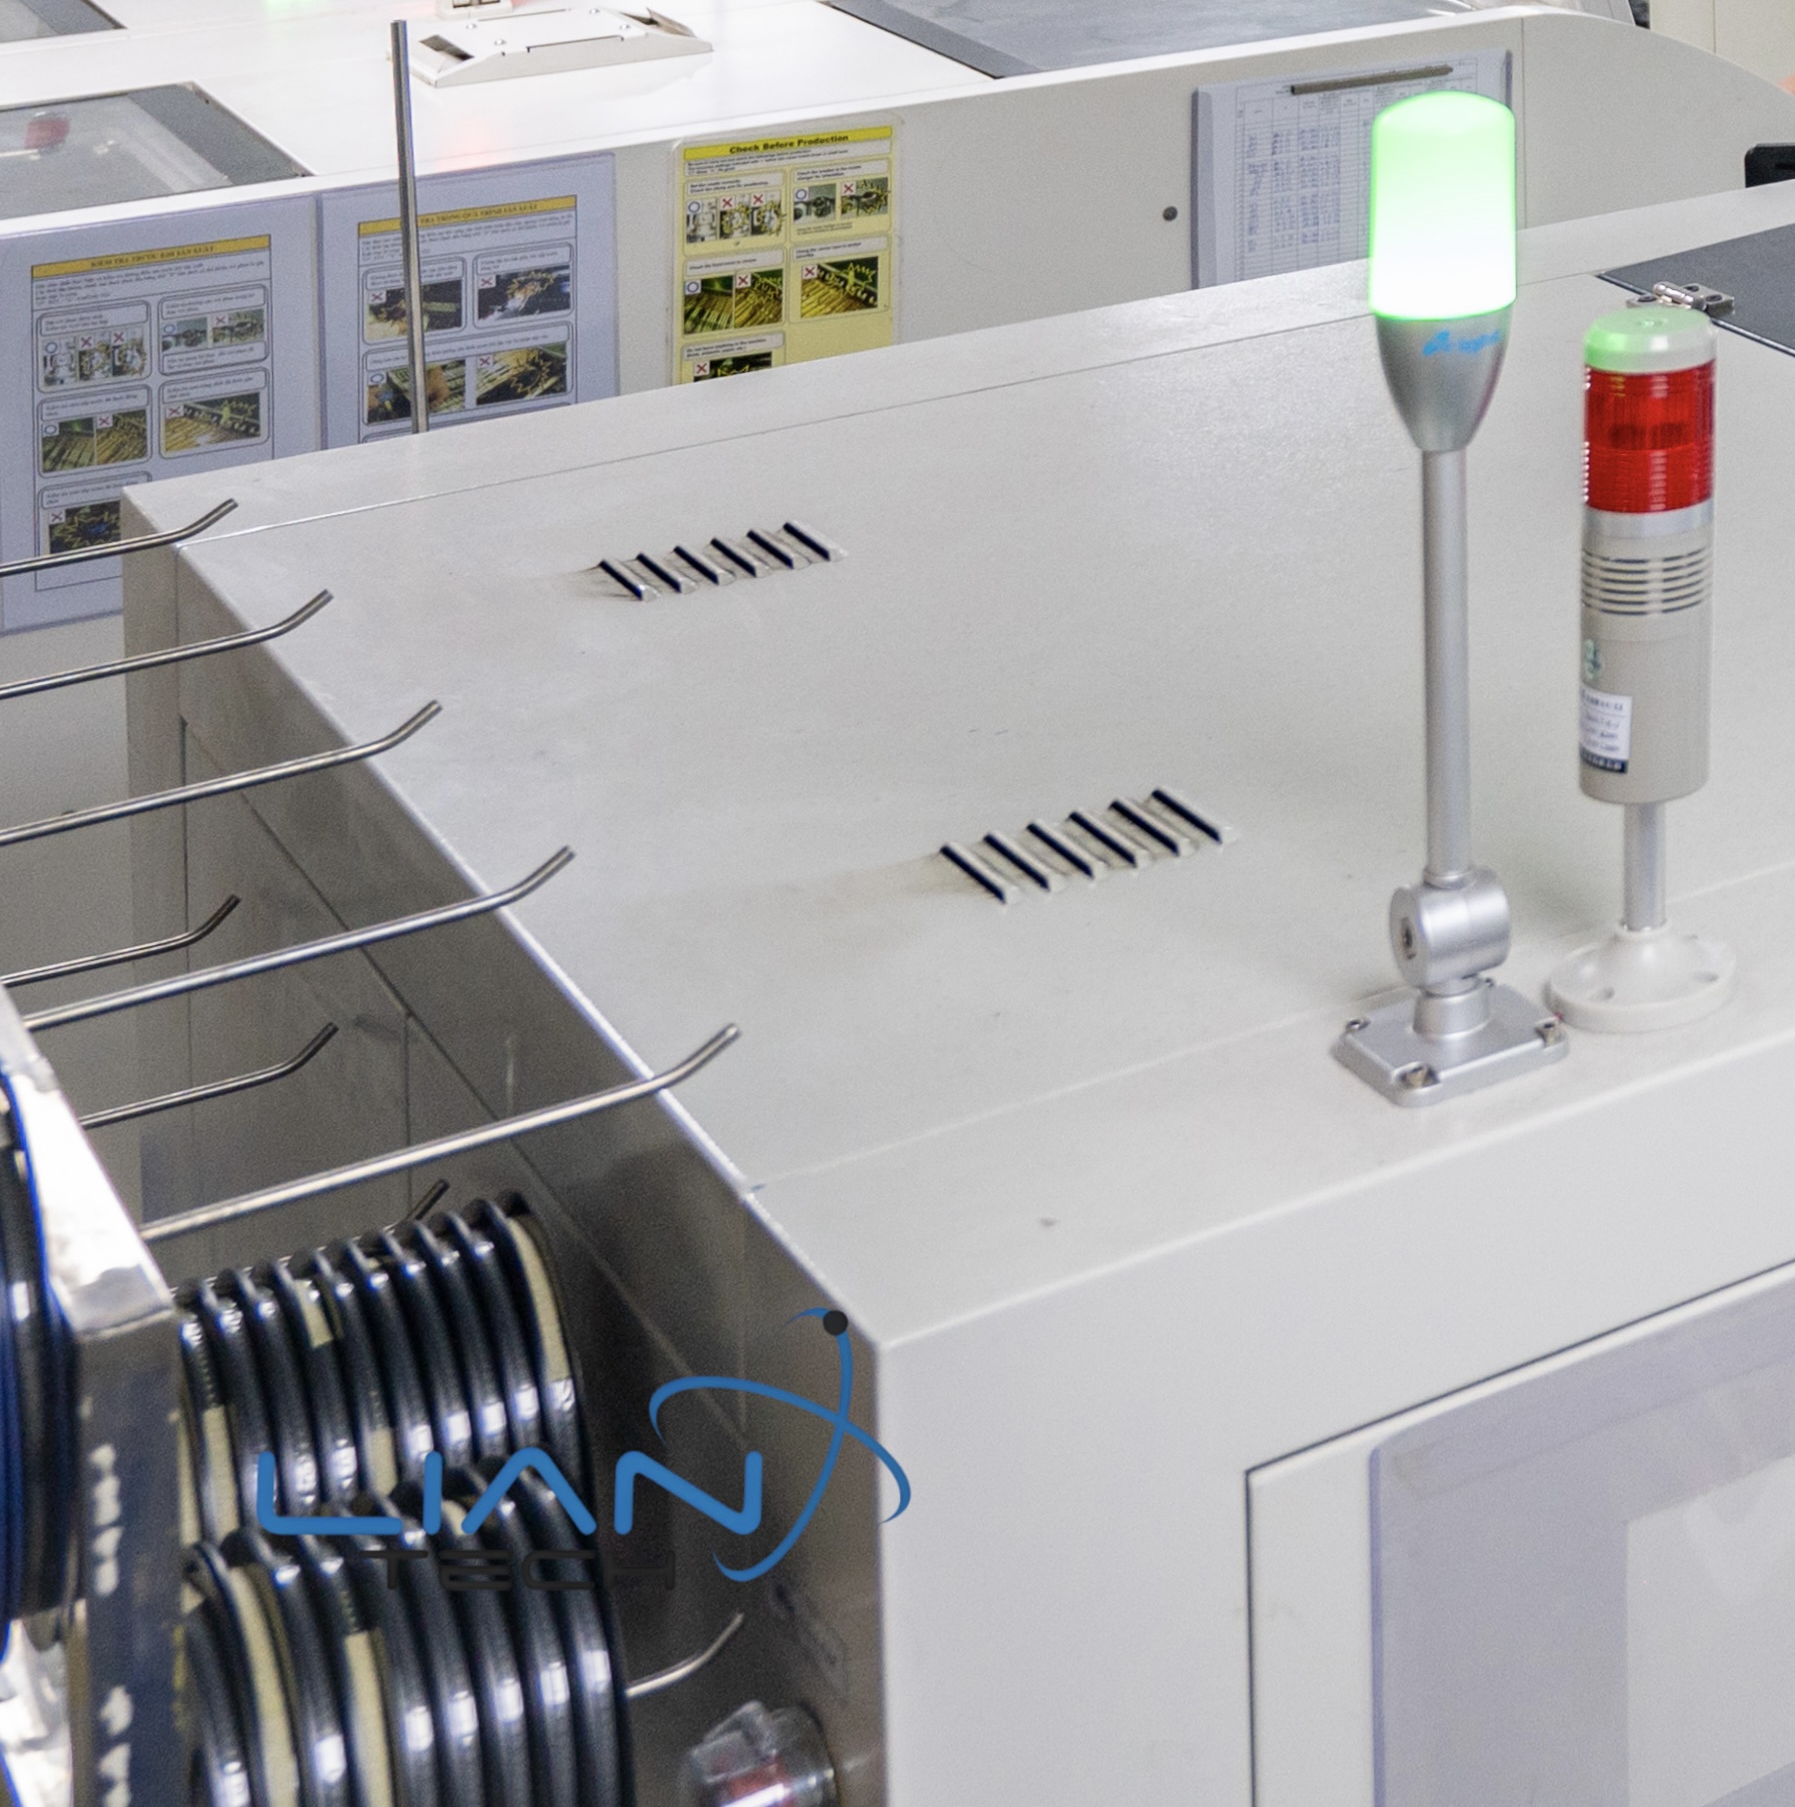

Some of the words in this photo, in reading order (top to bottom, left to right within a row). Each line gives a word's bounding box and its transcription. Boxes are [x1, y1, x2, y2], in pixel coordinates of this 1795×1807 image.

[729, 144, 760, 155] Check
[763, 139, 795, 151] Before
[797, 134, 849, 147] Production
